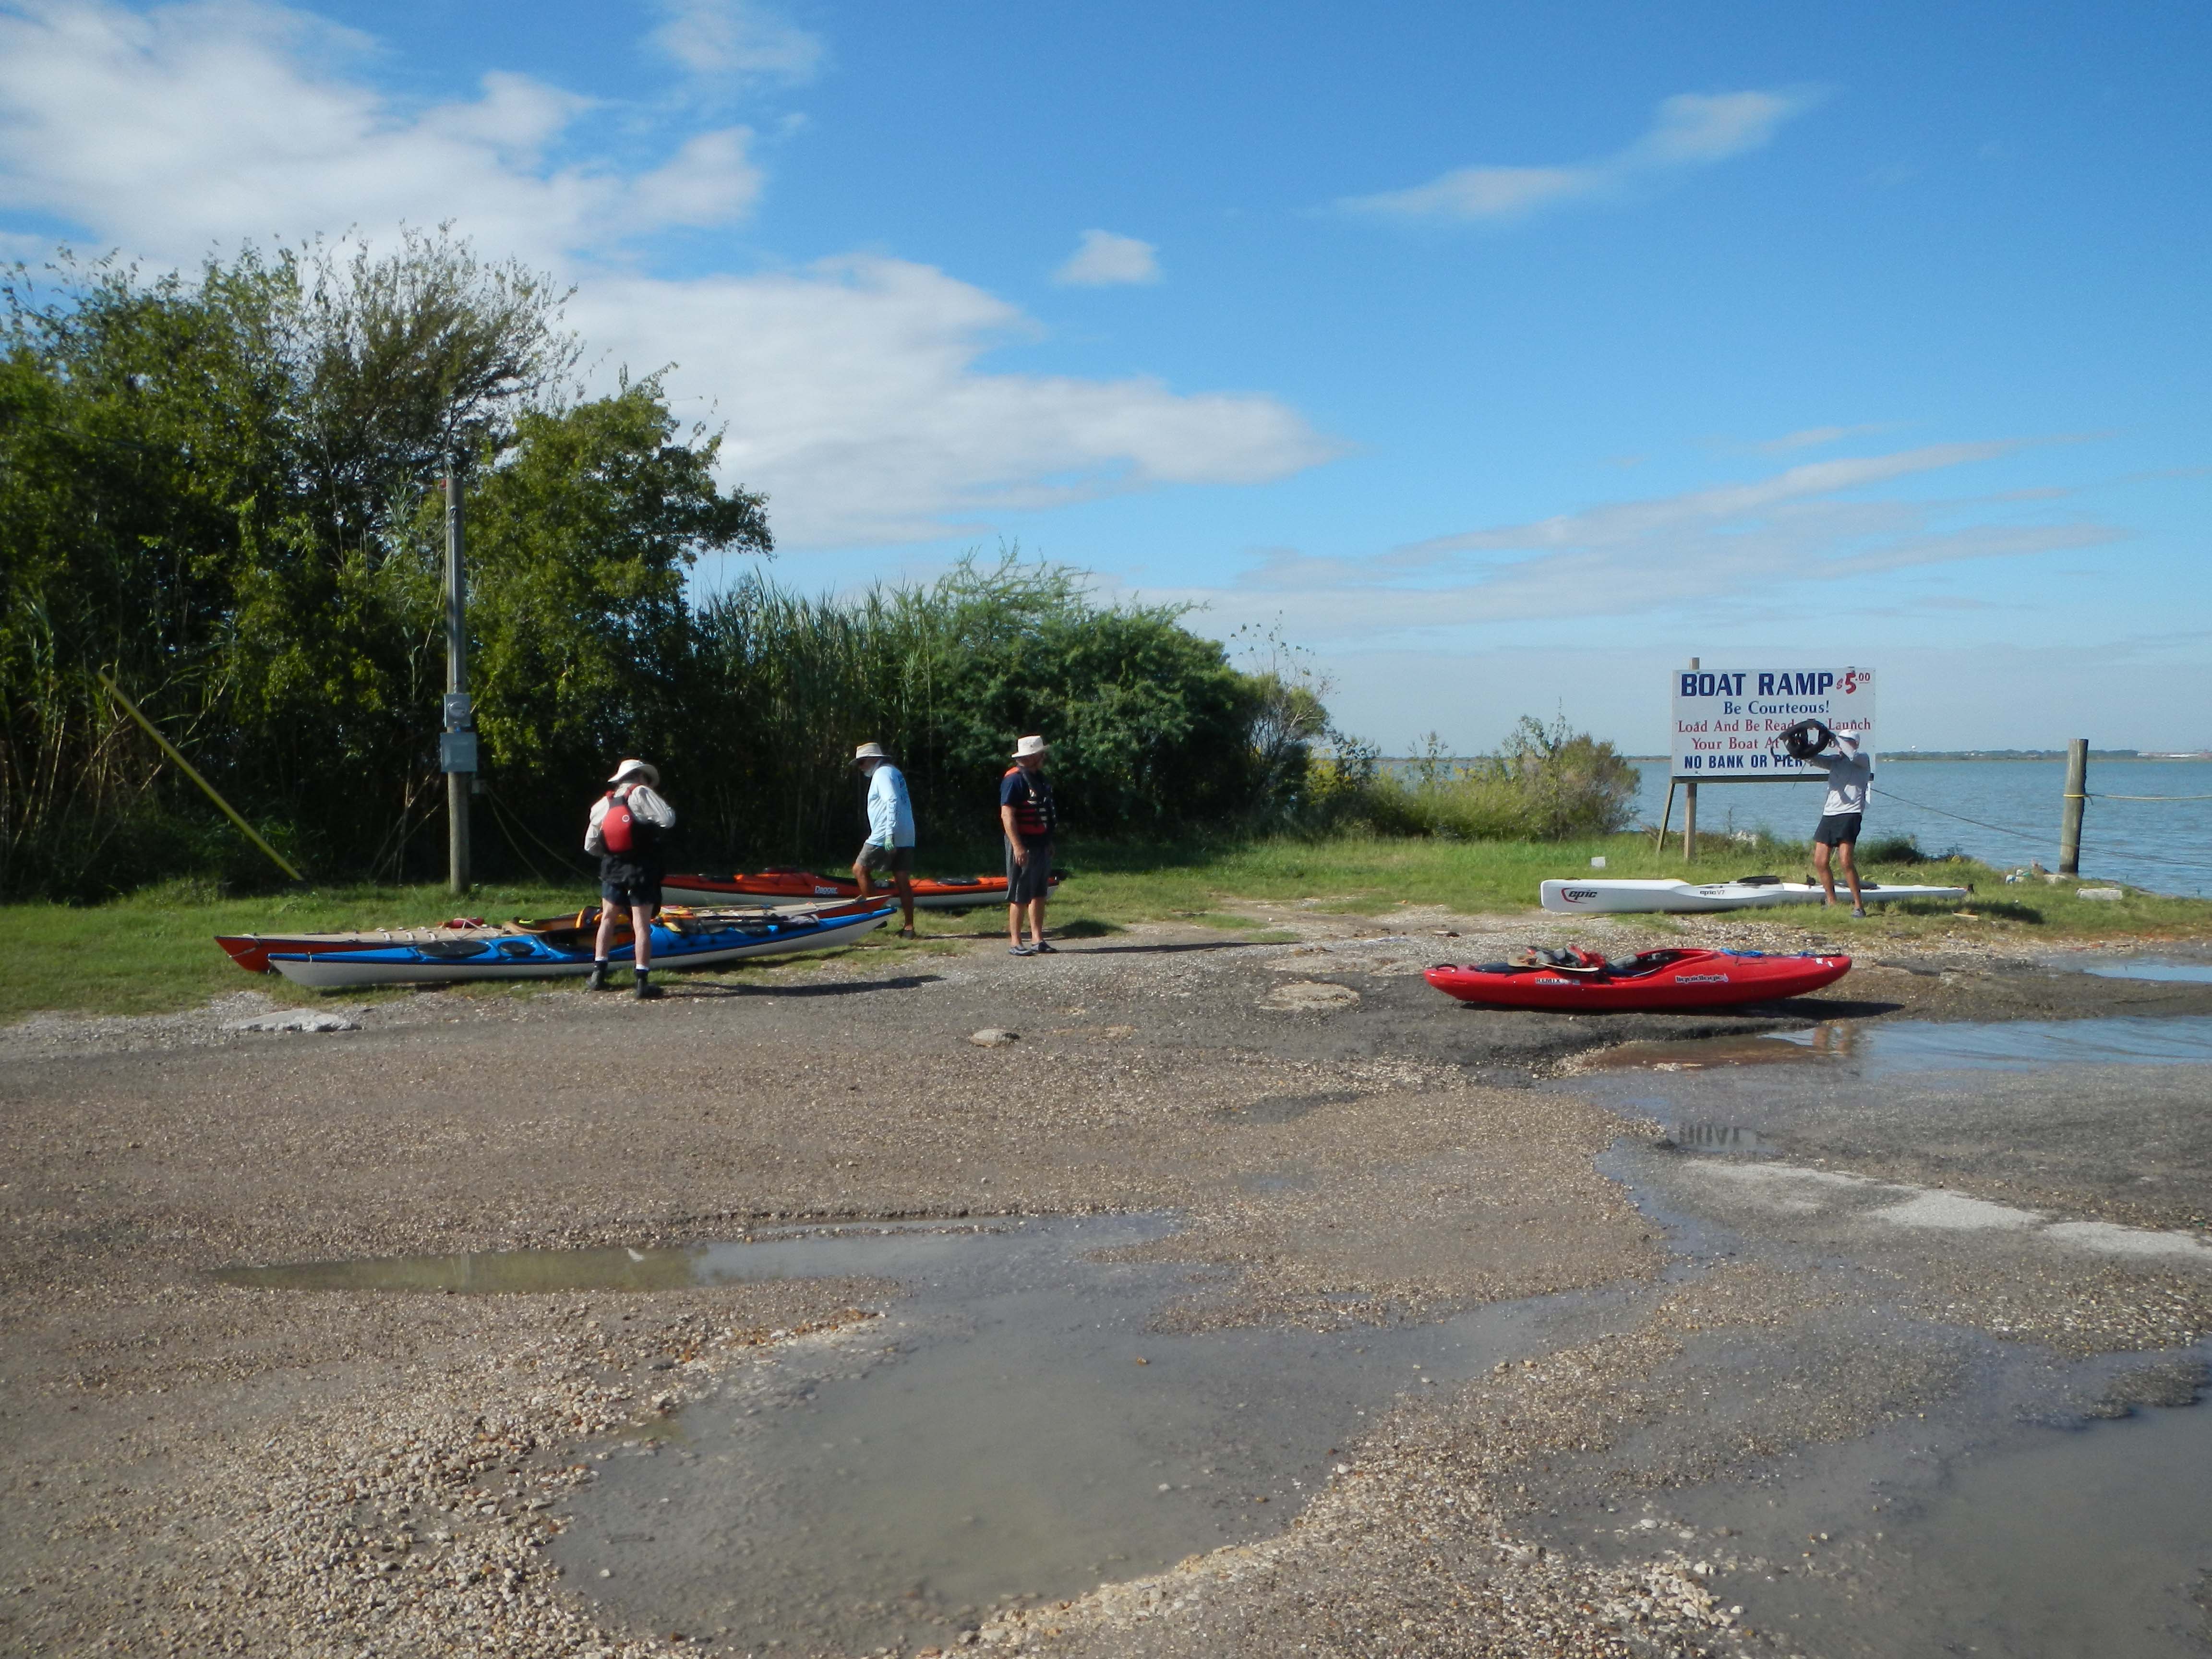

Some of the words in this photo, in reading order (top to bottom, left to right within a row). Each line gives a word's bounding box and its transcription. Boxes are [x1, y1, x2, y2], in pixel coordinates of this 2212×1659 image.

[1681, 673, 1746, 697] BOAT
[1758, 672, 1833, 696] RAMP
[1723, 701, 1741, 715] Be
[1748, 700, 1829, 714] Courteous!
[1678, 720, 1707, 733] Load
[1714, 720, 1739, 732] And
[1745, 719, 1760, 732] Be
[1765, 719, 1794, 731] Read
[1828, 718, 1870, 731] Launch
[1691, 737, 1722, 750] Your
[1729, 736, 1758, 749] Boat
[1764, 736, 1779, 749] At
[1684, 755, 1702, 769] NO
[1708, 755, 1743, 768] BANK
[1751, 754, 1767, 768] OR
[1568, 890, 1598, 900] epic
